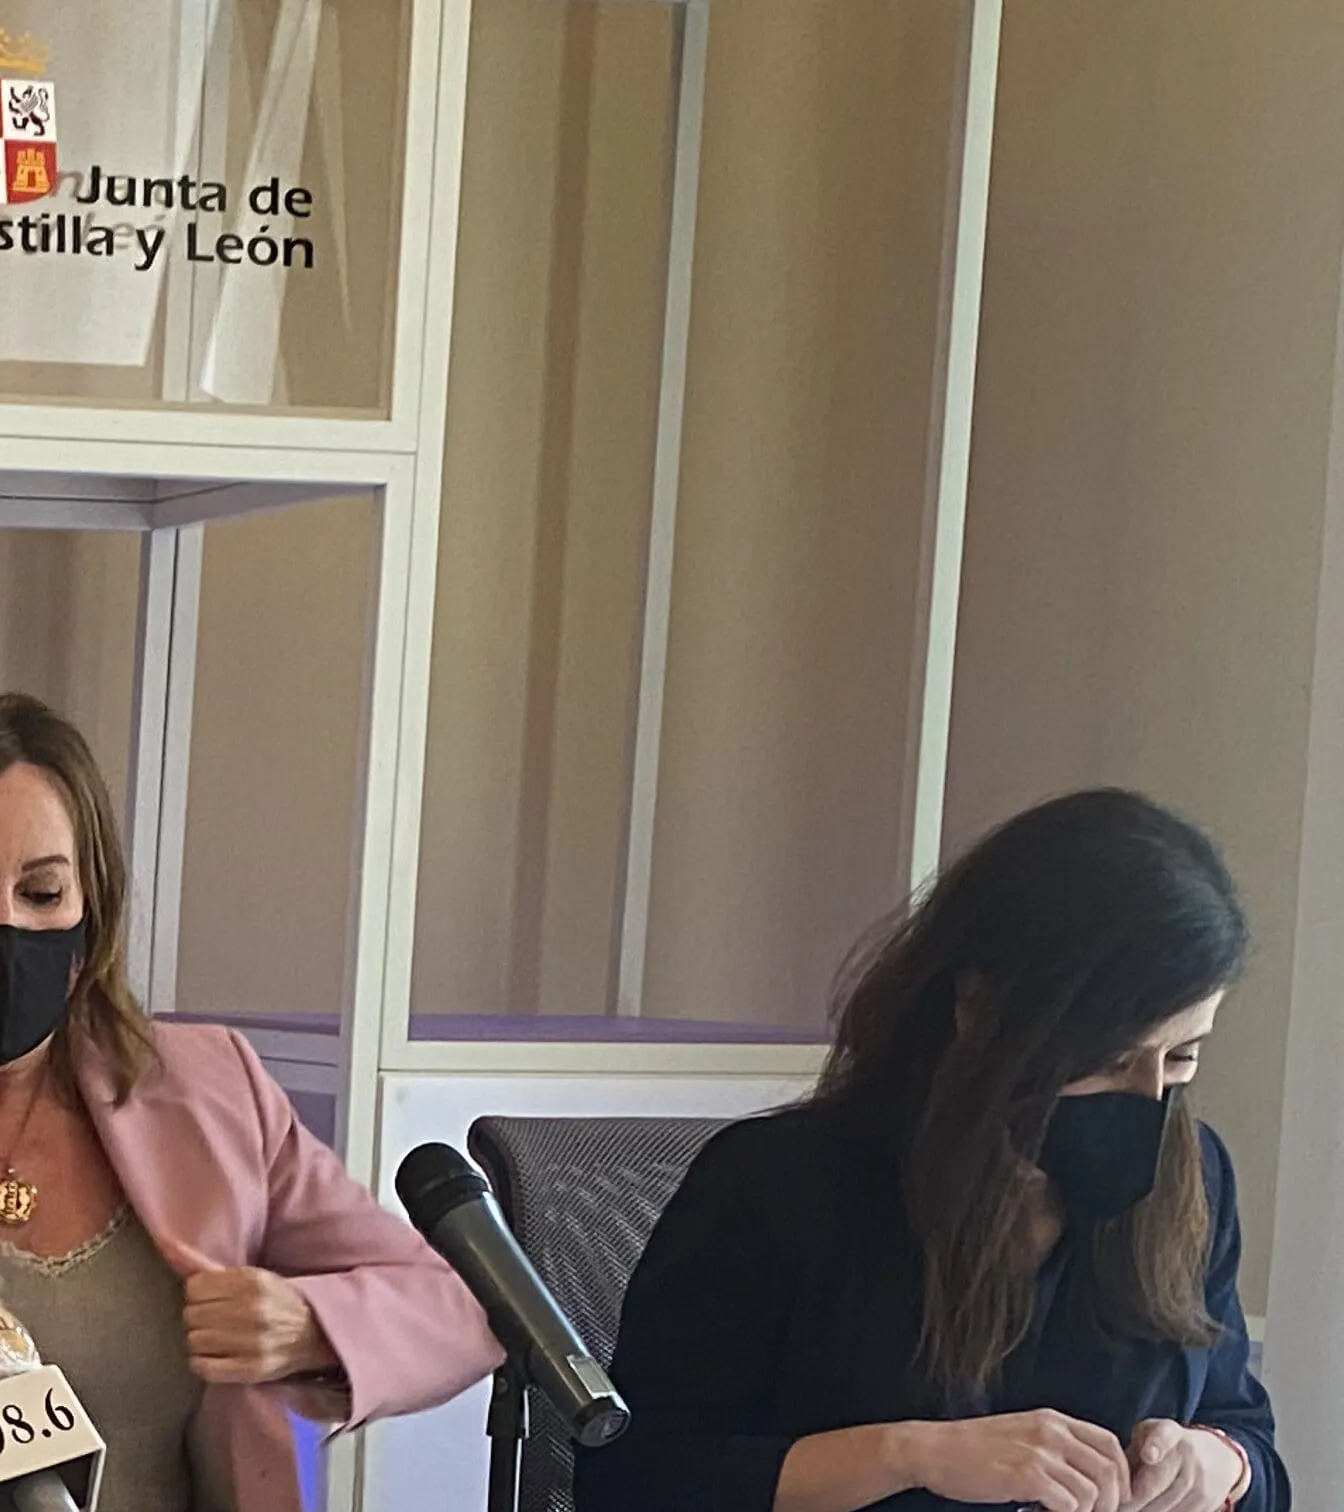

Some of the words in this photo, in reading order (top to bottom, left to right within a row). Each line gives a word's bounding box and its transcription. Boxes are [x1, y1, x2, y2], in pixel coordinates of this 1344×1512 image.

[77, 166, 227, 211] Junta
[249, 177, 313, 218] de
[135, 229, 164, 271] y
[187, 223, 314, 269] León
